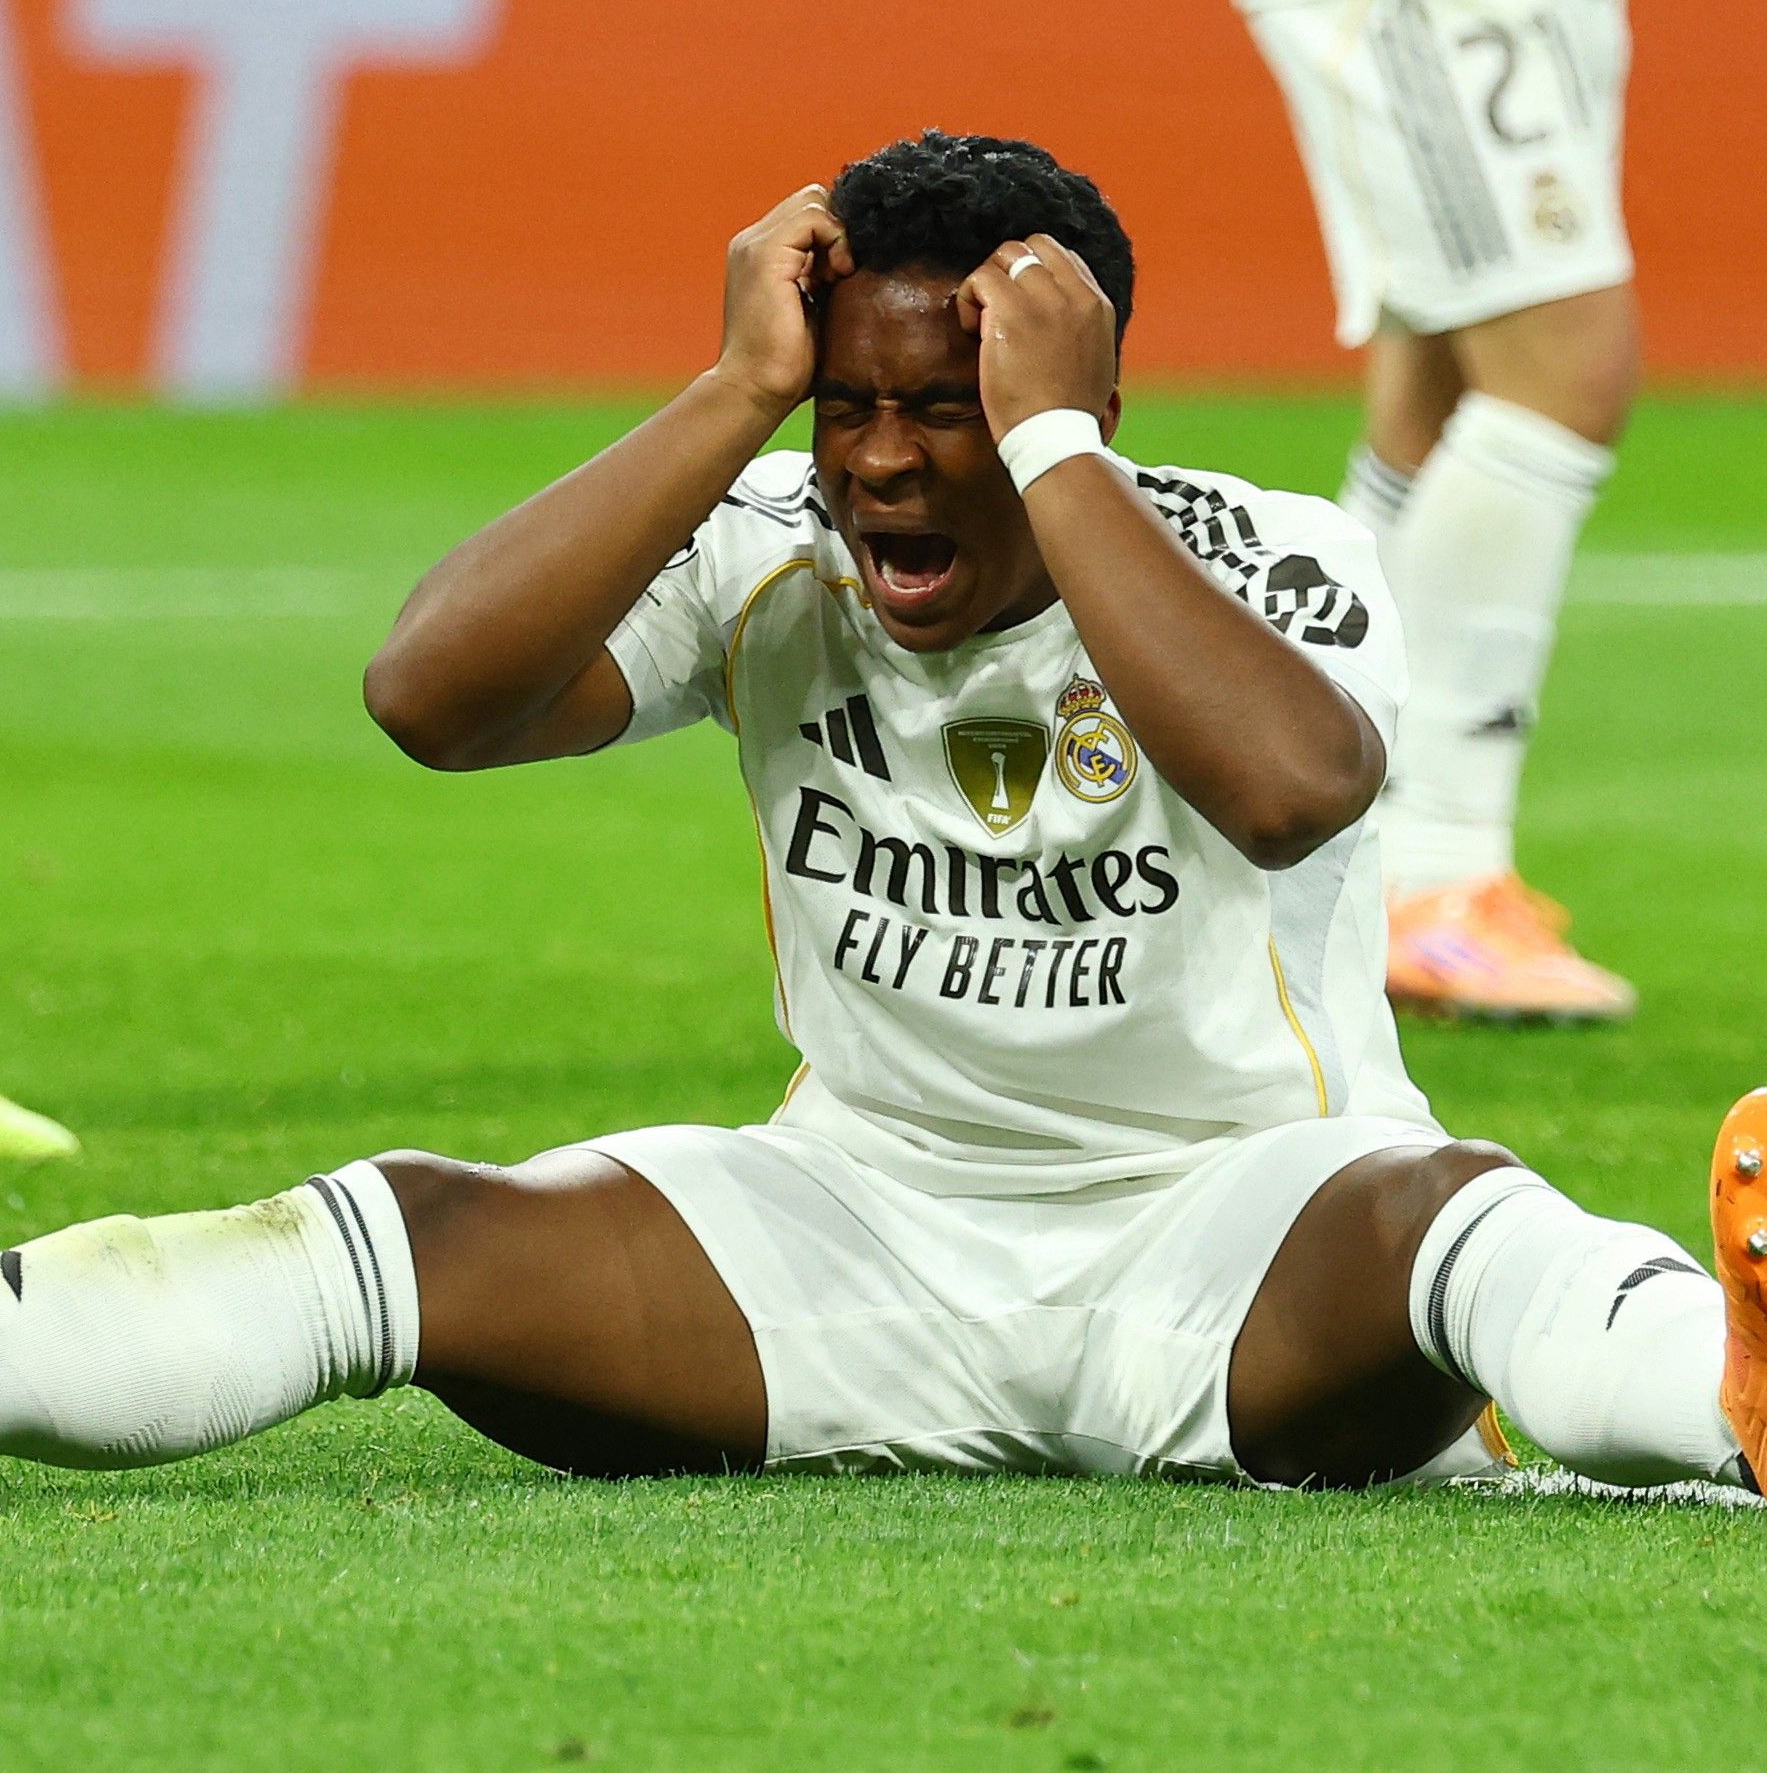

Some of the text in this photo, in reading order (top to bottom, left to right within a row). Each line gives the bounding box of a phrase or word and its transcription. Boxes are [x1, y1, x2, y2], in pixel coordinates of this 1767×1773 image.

[785, 785, 1180, 926] Emirates
[833, 908, 1128, 1009] FLY BETTER
